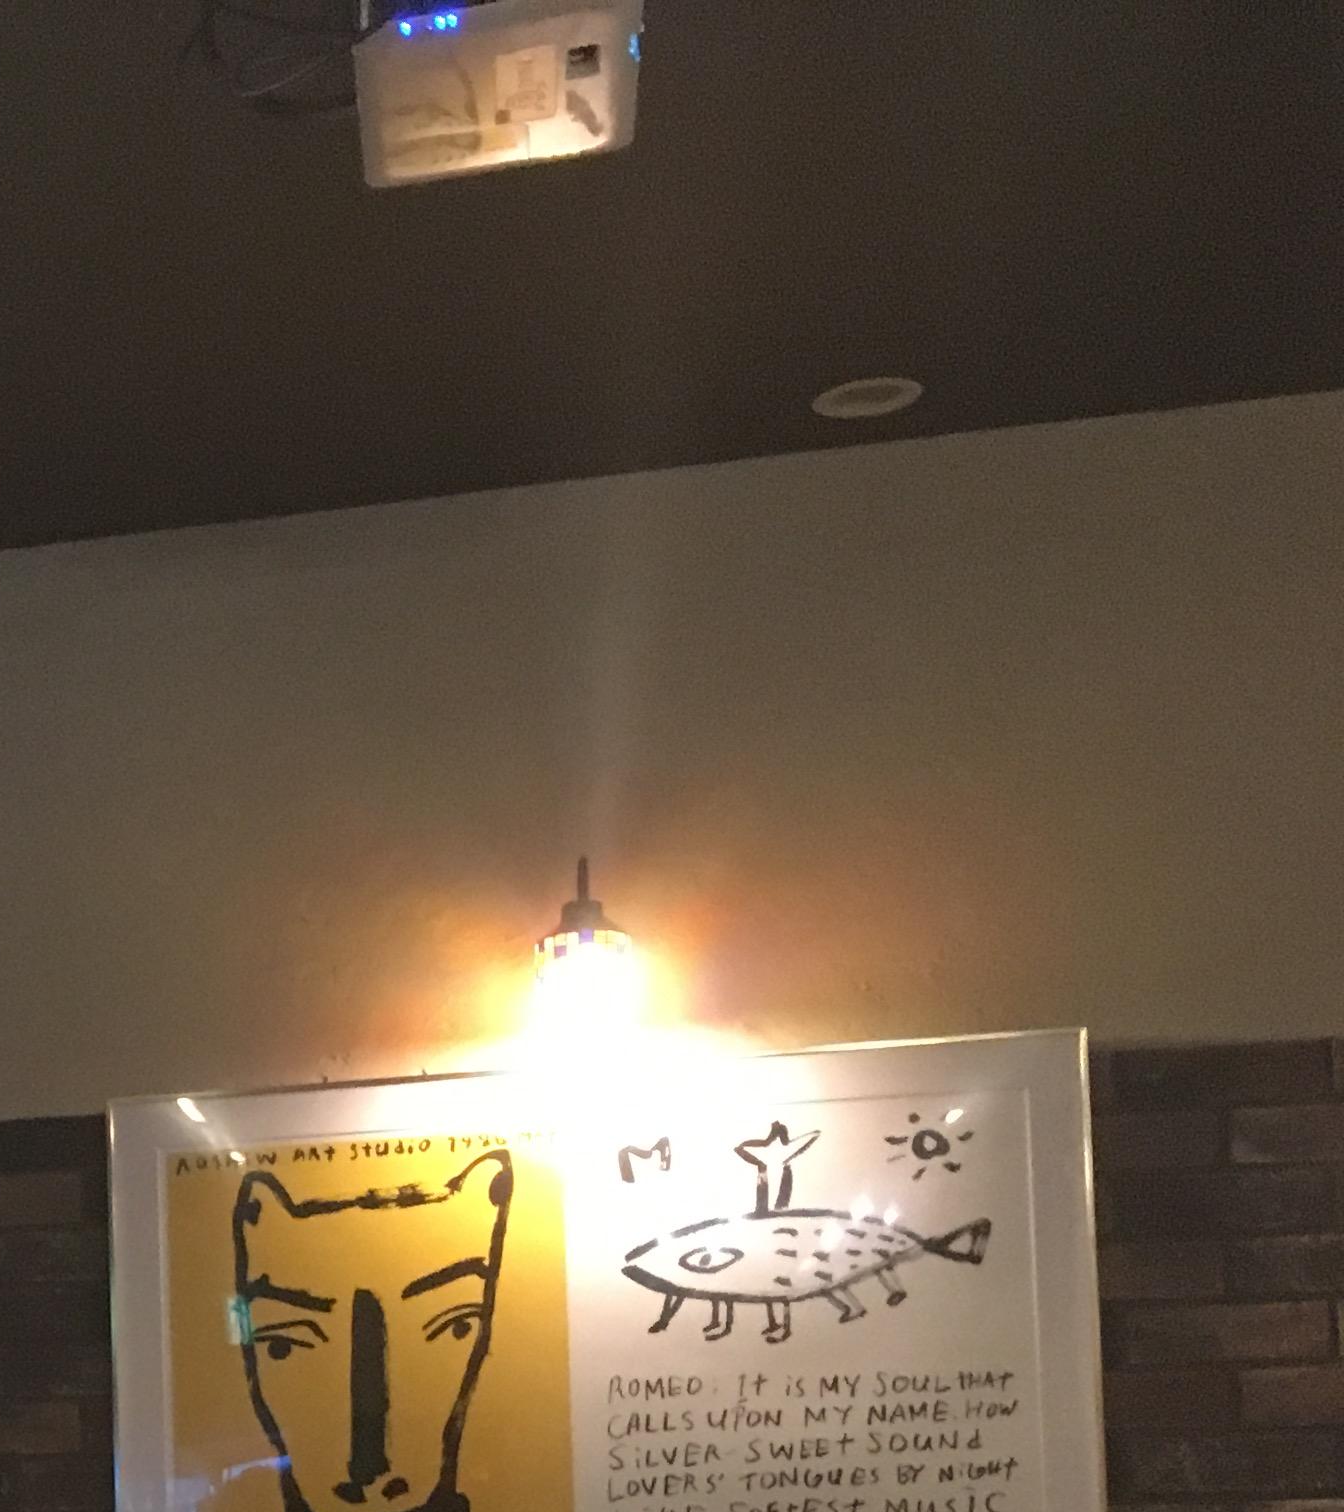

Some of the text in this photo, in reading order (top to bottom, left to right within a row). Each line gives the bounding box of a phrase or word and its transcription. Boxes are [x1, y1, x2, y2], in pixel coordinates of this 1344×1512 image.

[819, 1374, 860, 1398] MY
[876, 1371, 951, 1398] SOUL
[607, 1408, 695, 1440] CALLS
[707, 1404, 782, 1432] UPON
[804, 1405, 852, 1428] MY
[739, 1467, 880, 1493] TONGUES
[897, 1464, 925, 1485] BY
